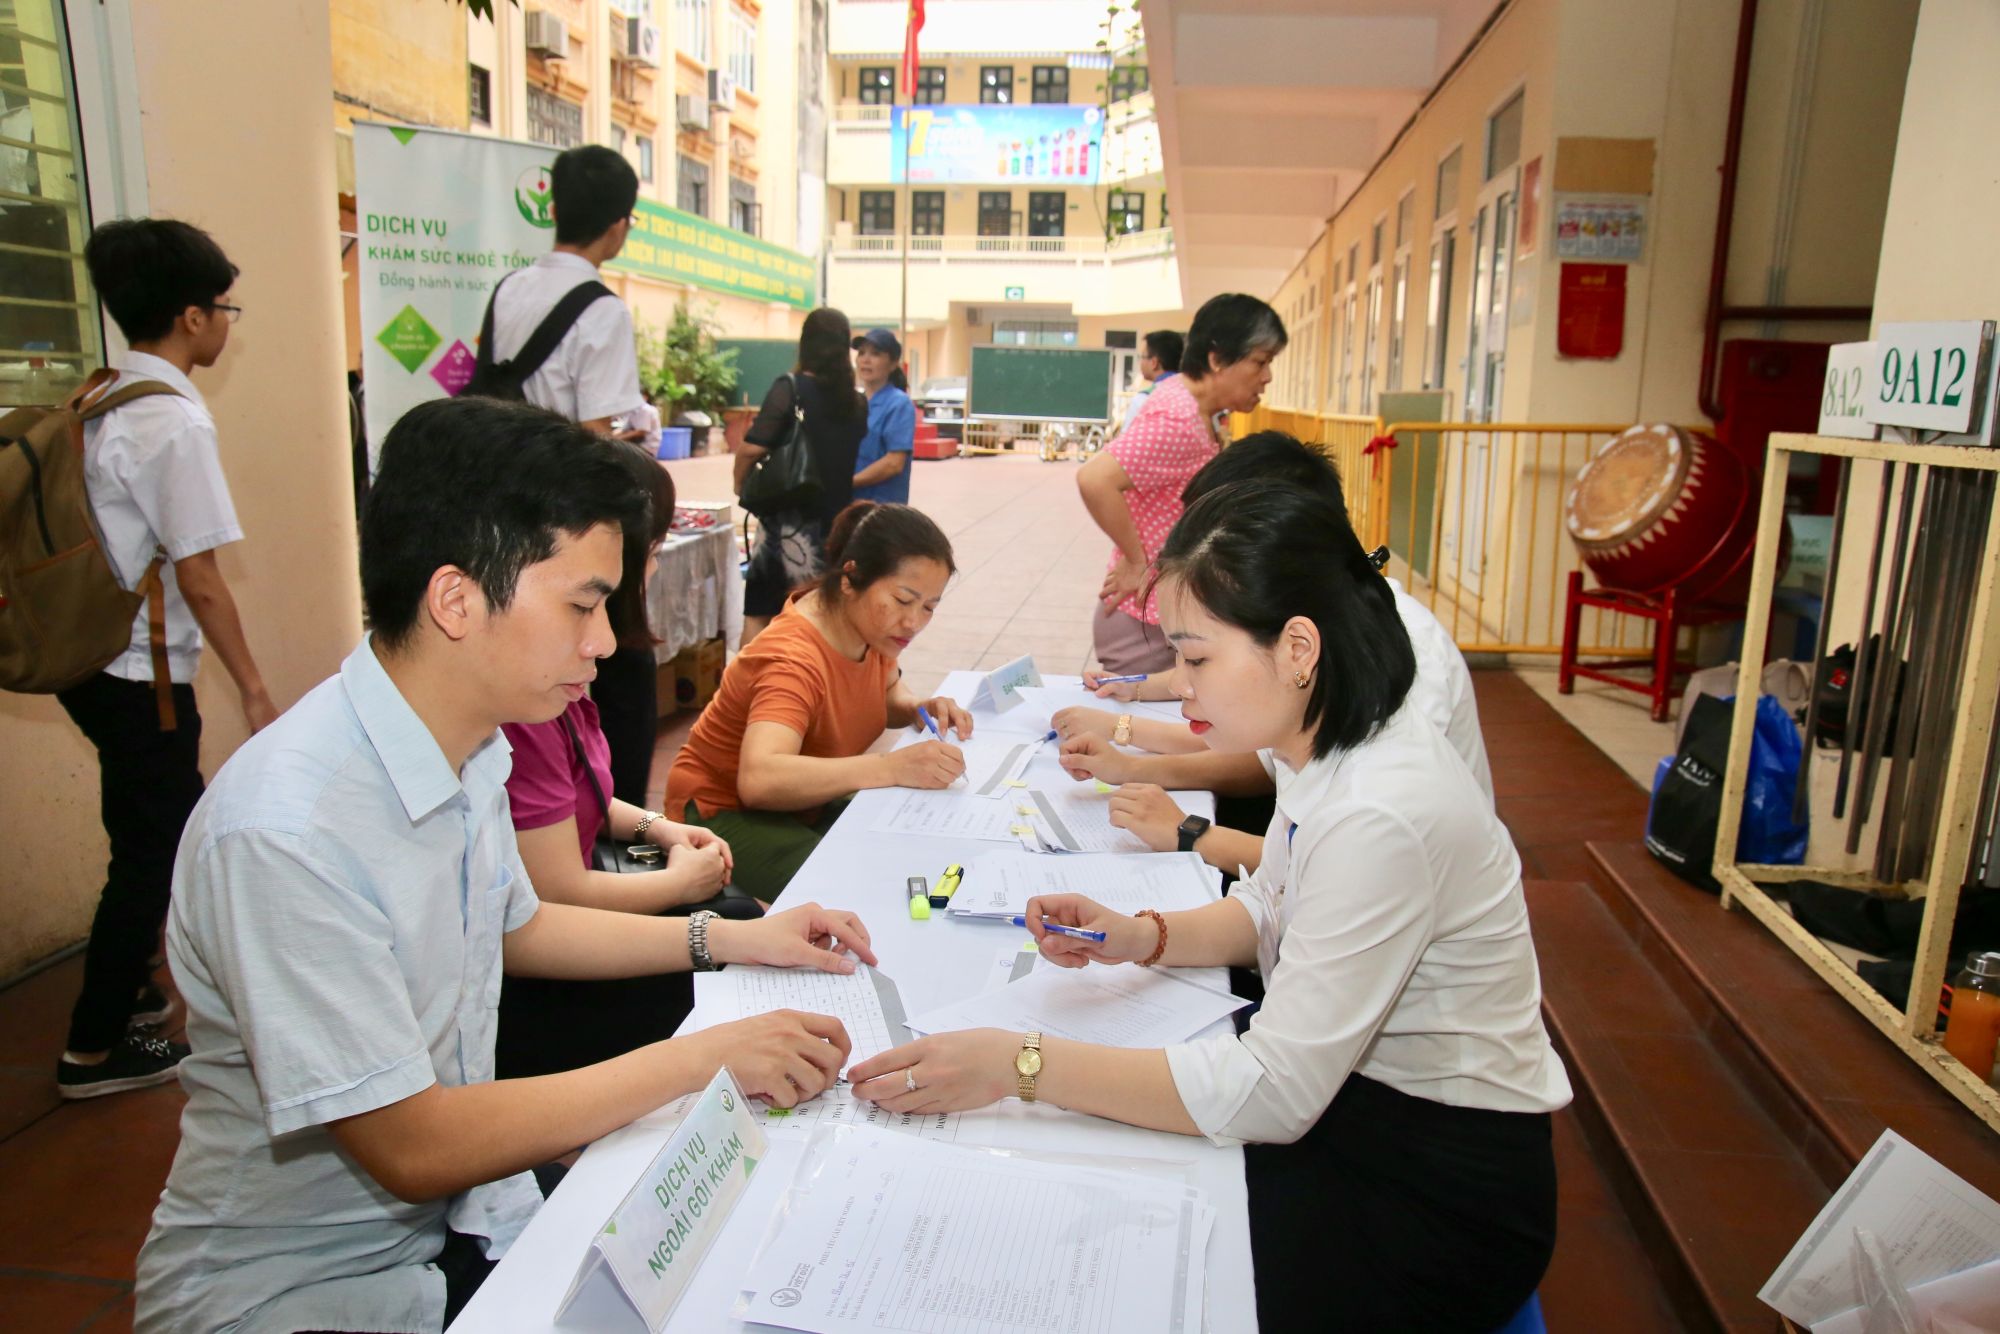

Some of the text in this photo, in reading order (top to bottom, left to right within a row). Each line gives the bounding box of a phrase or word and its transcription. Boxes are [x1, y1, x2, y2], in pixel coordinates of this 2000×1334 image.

[367, 214, 446, 242] DỊCH VỤ
[368, 242, 415, 261] KHÁM
[1879, 347, 1966, 407] 9A12
[655, 1131, 708, 1210] DỊCH VỤ
[647, 1131, 744, 1281] NGOÀI GÓI KHÁM
